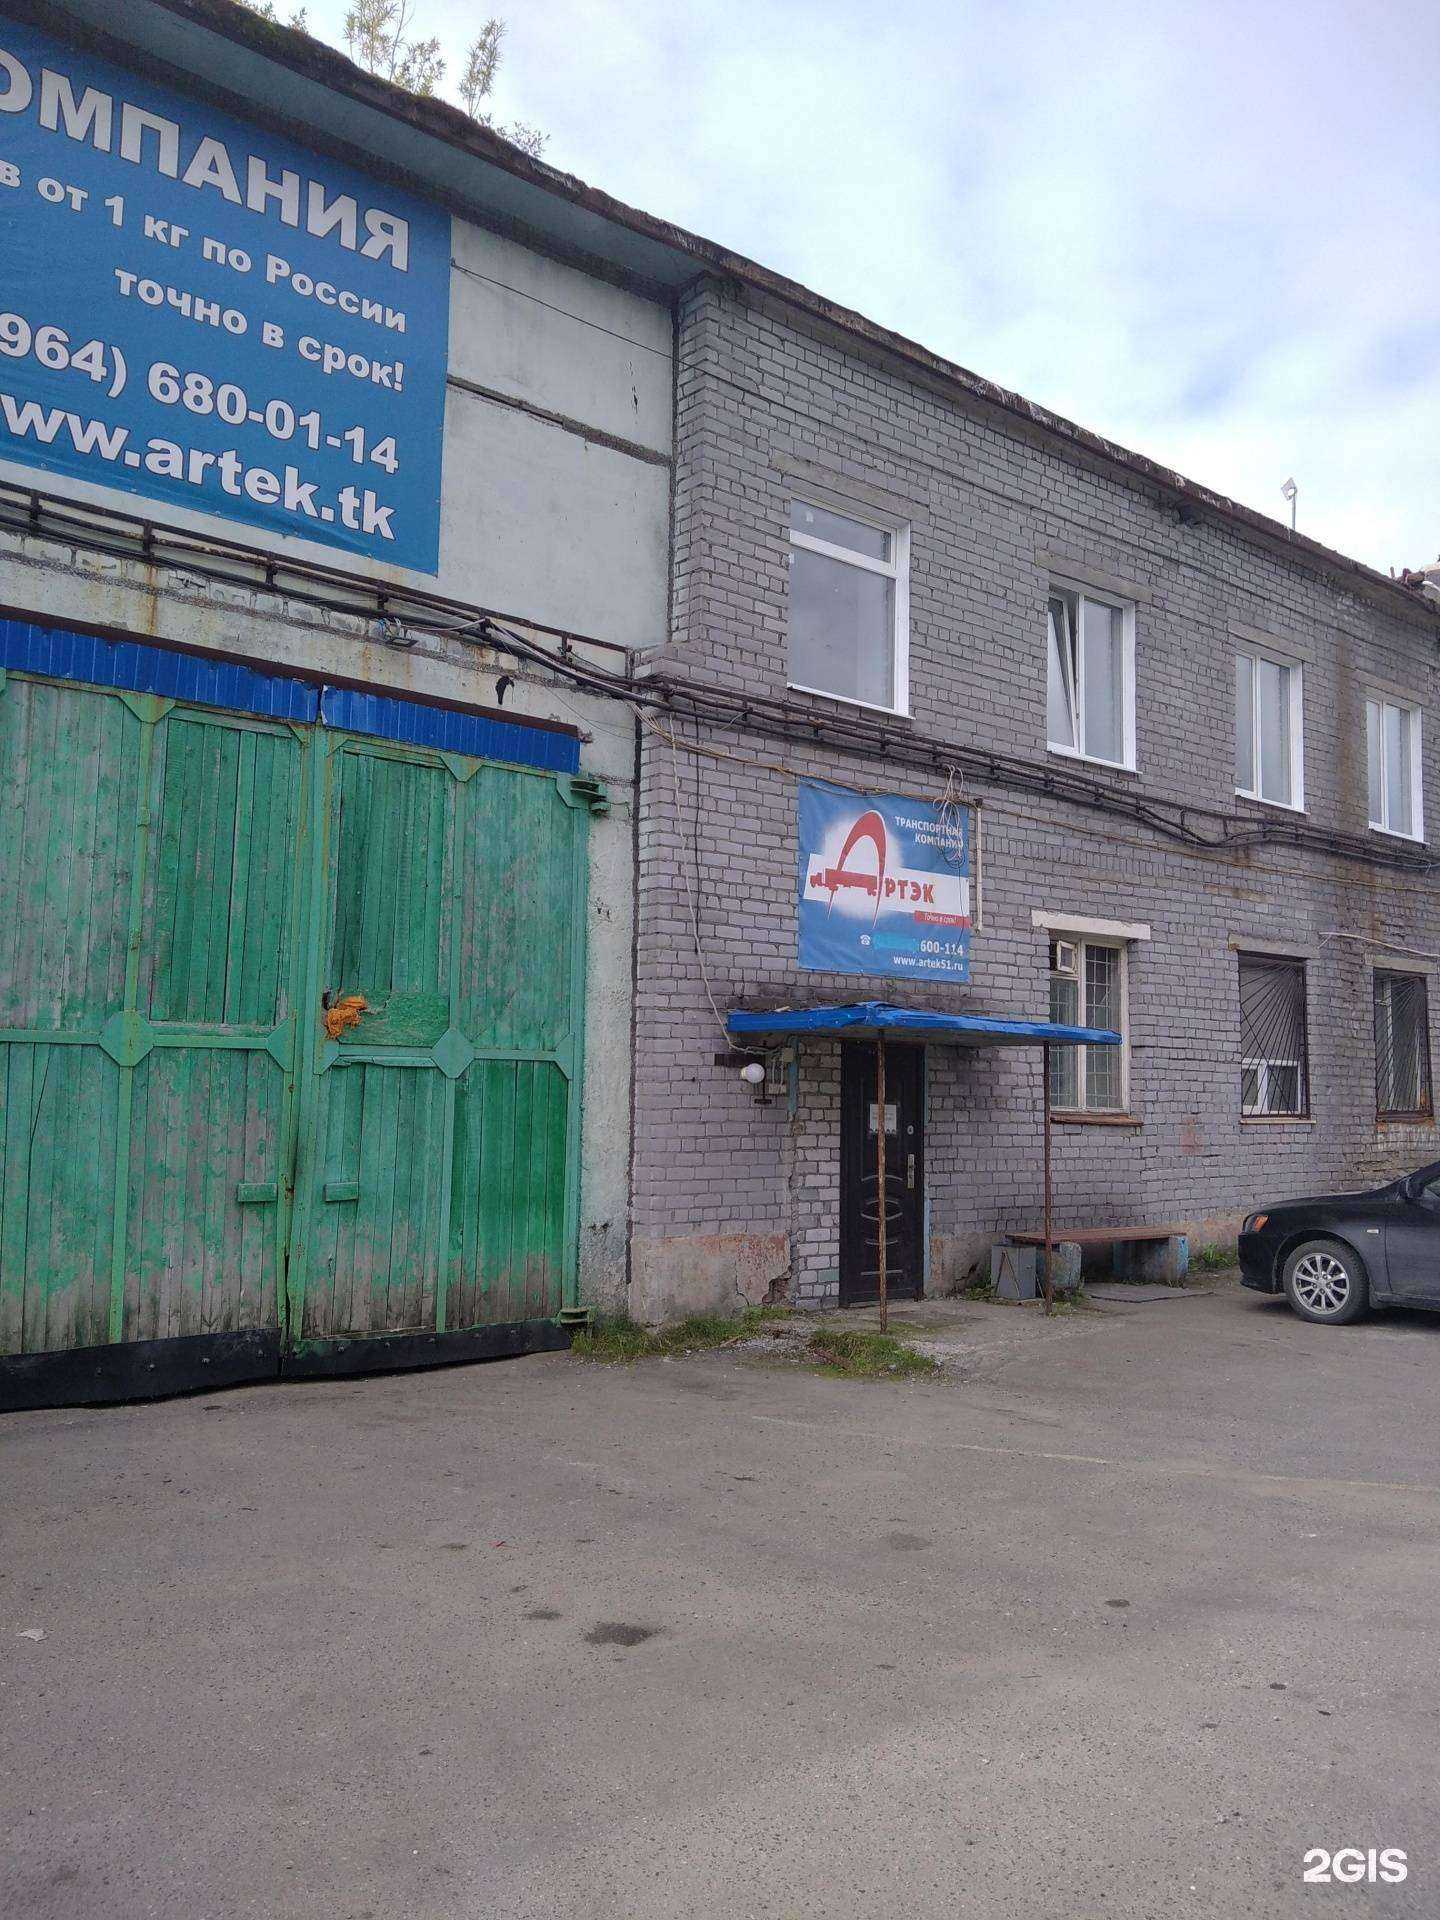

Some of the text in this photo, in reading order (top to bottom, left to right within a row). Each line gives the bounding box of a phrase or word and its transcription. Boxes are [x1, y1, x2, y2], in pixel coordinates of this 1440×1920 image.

[38, 177, 88, 211] от
[104, 195, 124, 227] 1
[144, 214, 189, 249] кг
[203, 236, 251, 272] по
[266, 254, 406, 333] России
[115, 268, 404, 391] точно в срок!
[148, 362, 399, 474] 680-01-14
[893, 956, 963, 971] www.artek51.ru
[920, 940, 963, 956] 600-114
